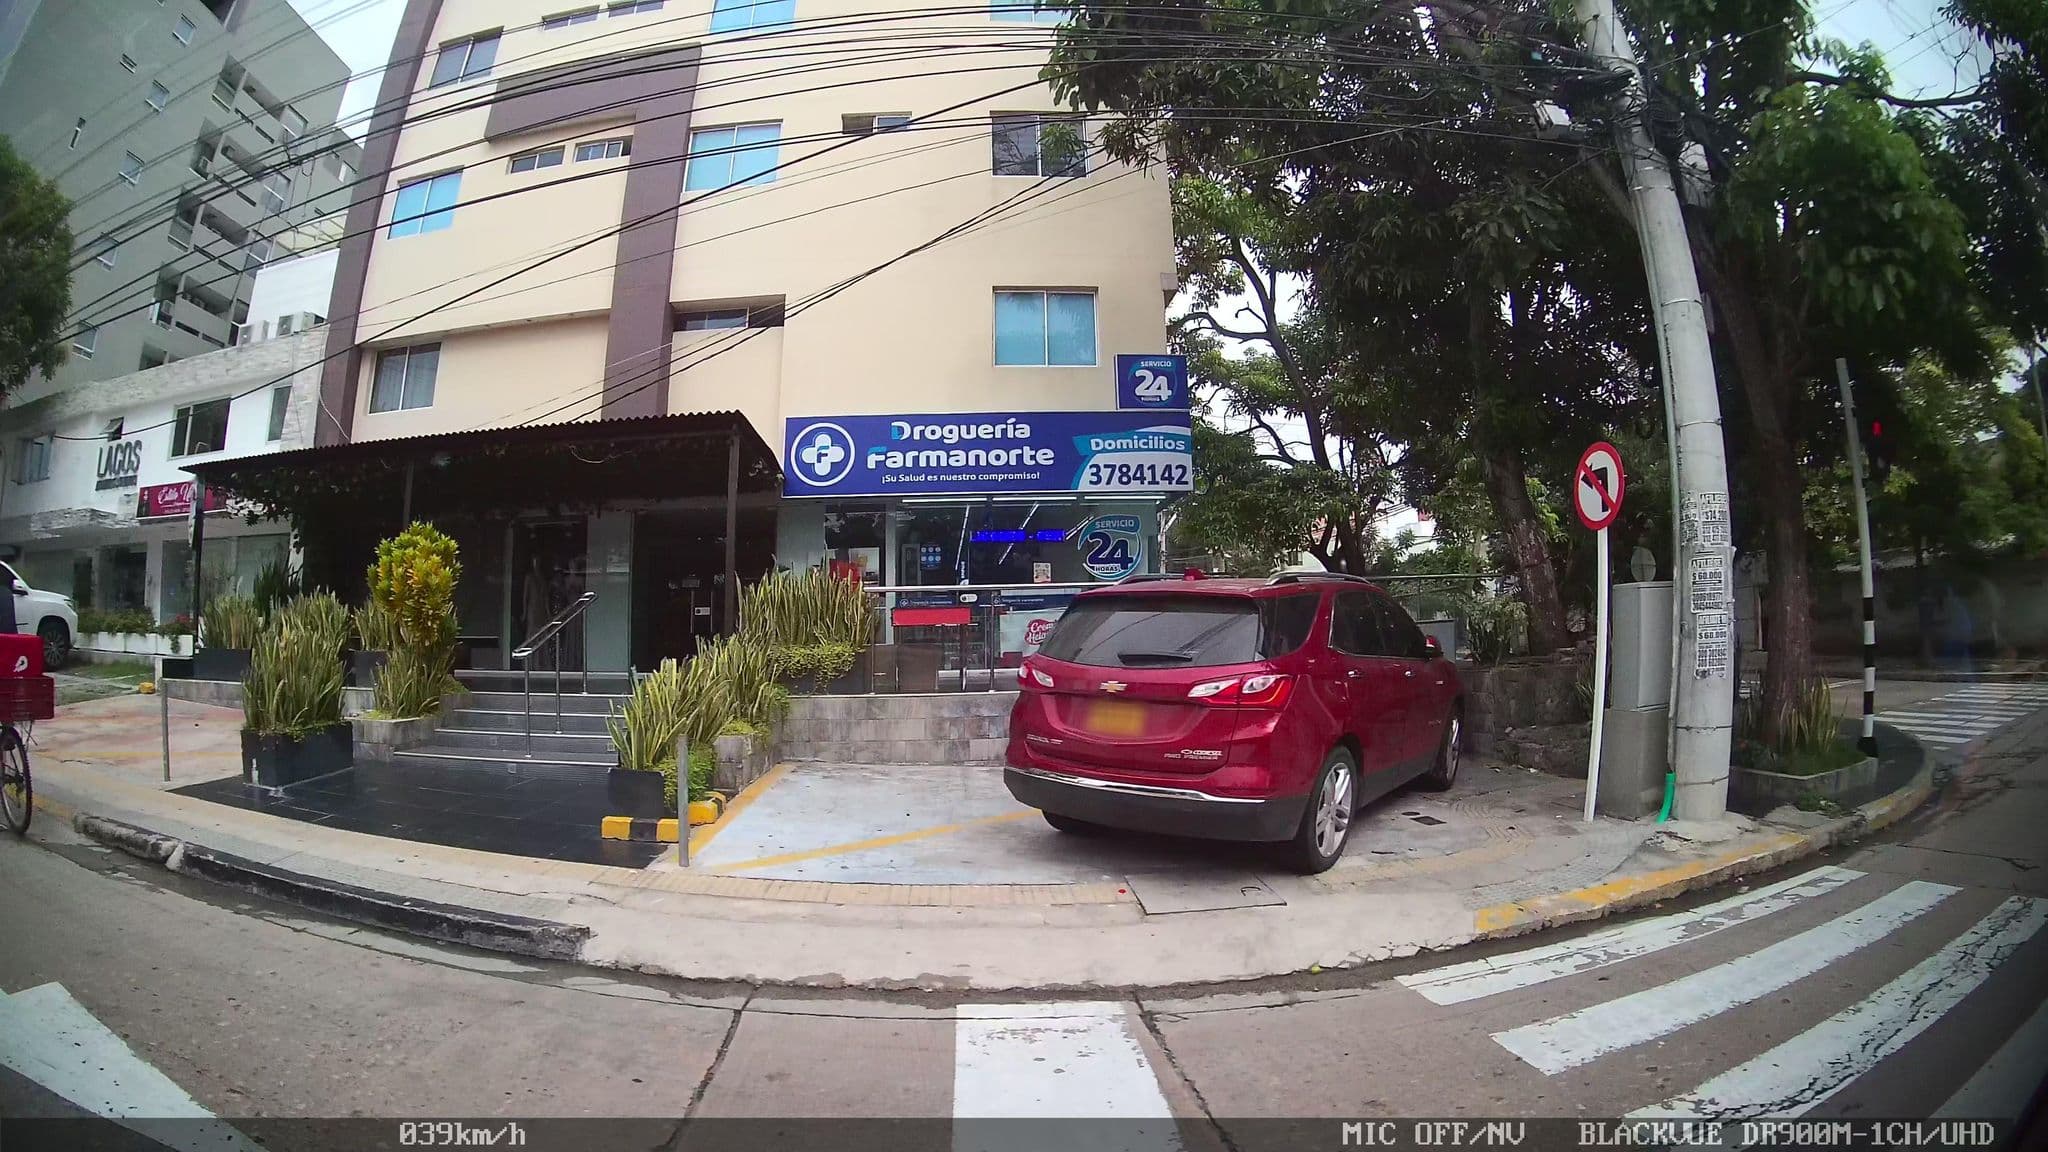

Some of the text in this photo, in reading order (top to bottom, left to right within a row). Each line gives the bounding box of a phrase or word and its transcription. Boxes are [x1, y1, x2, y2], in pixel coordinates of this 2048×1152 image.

[1135, 369, 1172, 401] 24
[891, 418, 1030, 443] Droguería
[1090, 436, 1185, 450] Domicilios
[97, 440, 142, 478] LAGOS
[867, 446, 1055, 469] Farmanorte
[882, 471, 1041, 484] ¡Su Salud es nuestro compromiso!
[1089, 463, 1189, 485] 3784142
[1095, 519, 1134, 529] SERVICIO
[1087, 530, 1134, 570] 24
